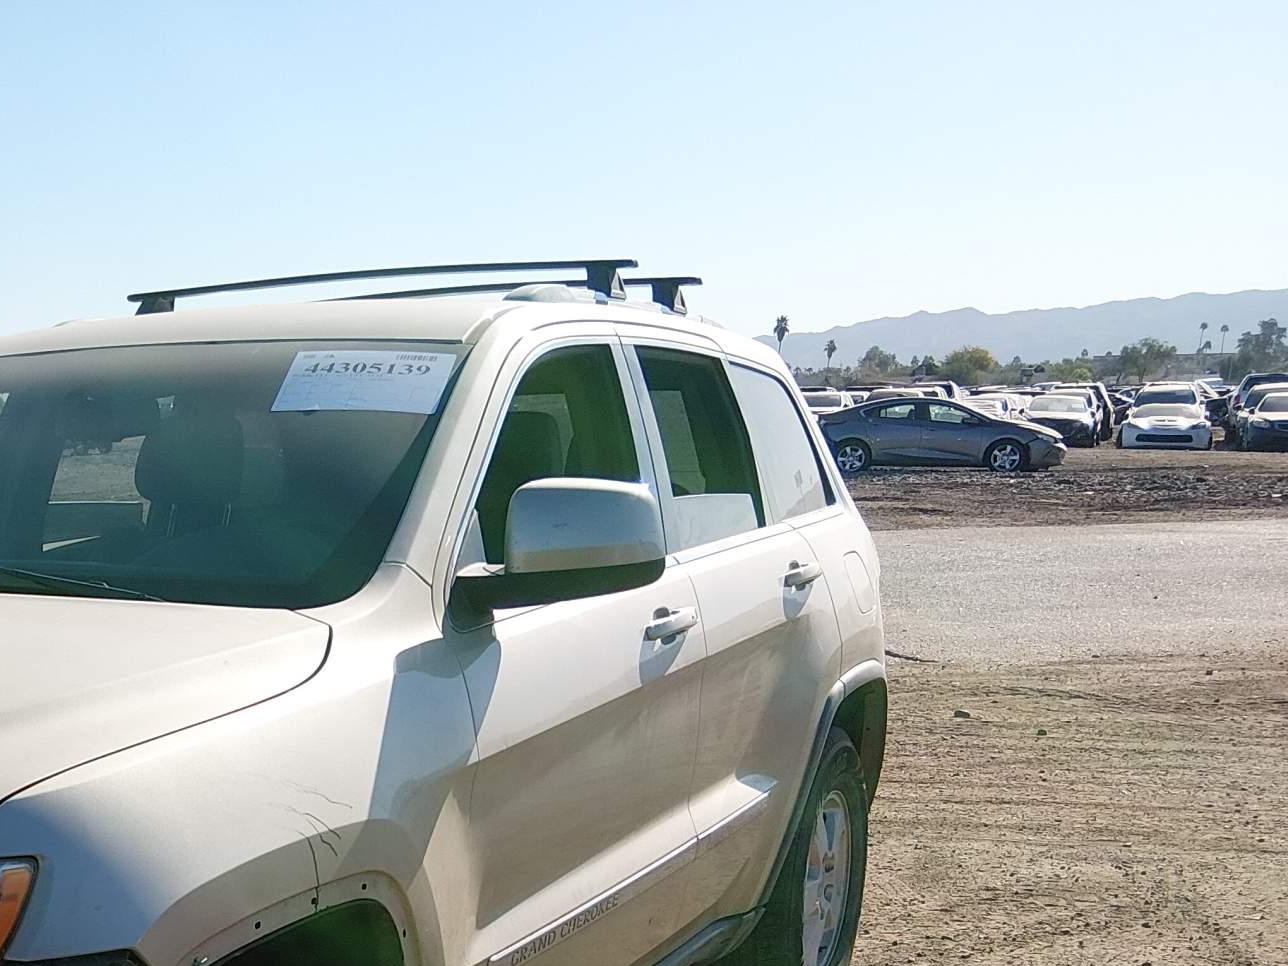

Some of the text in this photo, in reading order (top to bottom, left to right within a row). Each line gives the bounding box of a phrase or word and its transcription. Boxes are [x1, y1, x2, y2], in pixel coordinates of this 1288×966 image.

[304, 361, 431, 375] 44305139
[511, 894, 620, 966] GRAND CHEROKEE
